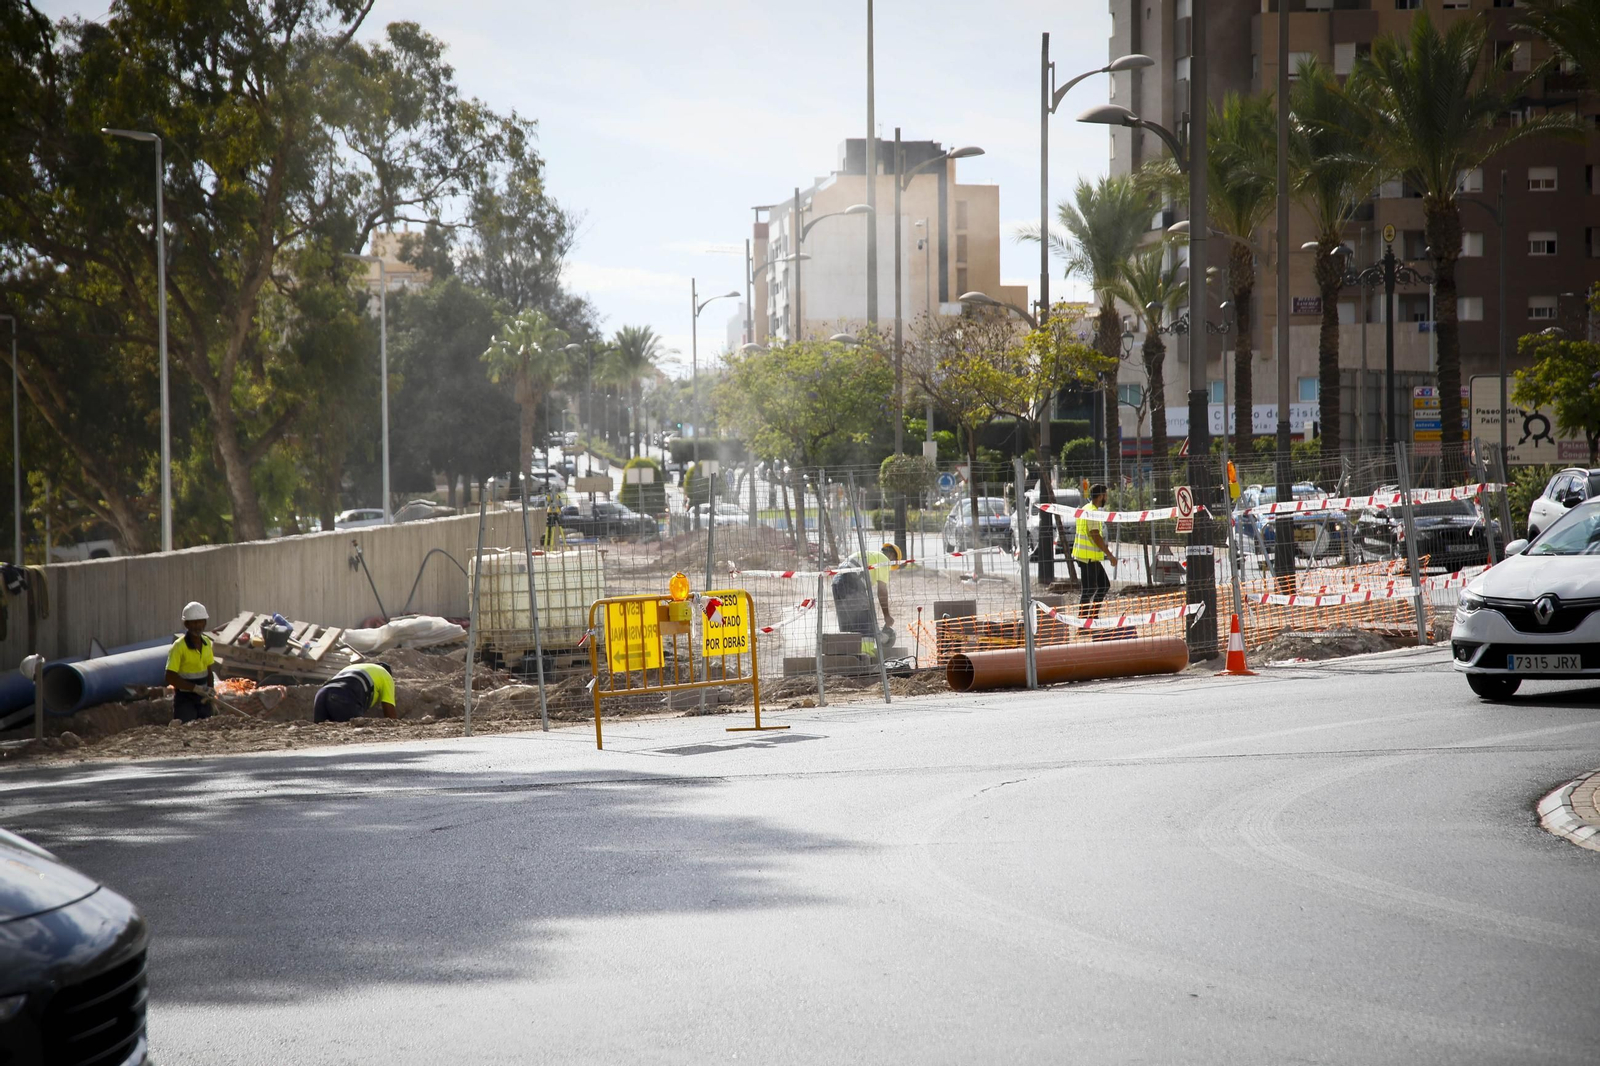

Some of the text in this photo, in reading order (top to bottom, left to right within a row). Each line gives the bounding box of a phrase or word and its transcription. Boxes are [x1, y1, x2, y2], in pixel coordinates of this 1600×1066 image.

[716, 594, 738, 607] CESO
[709, 615, 741, 629] COTADO
[705, 636, 746, 650] POR OBRAS
[1516, 656, 1578, 669] 7315 JRX
